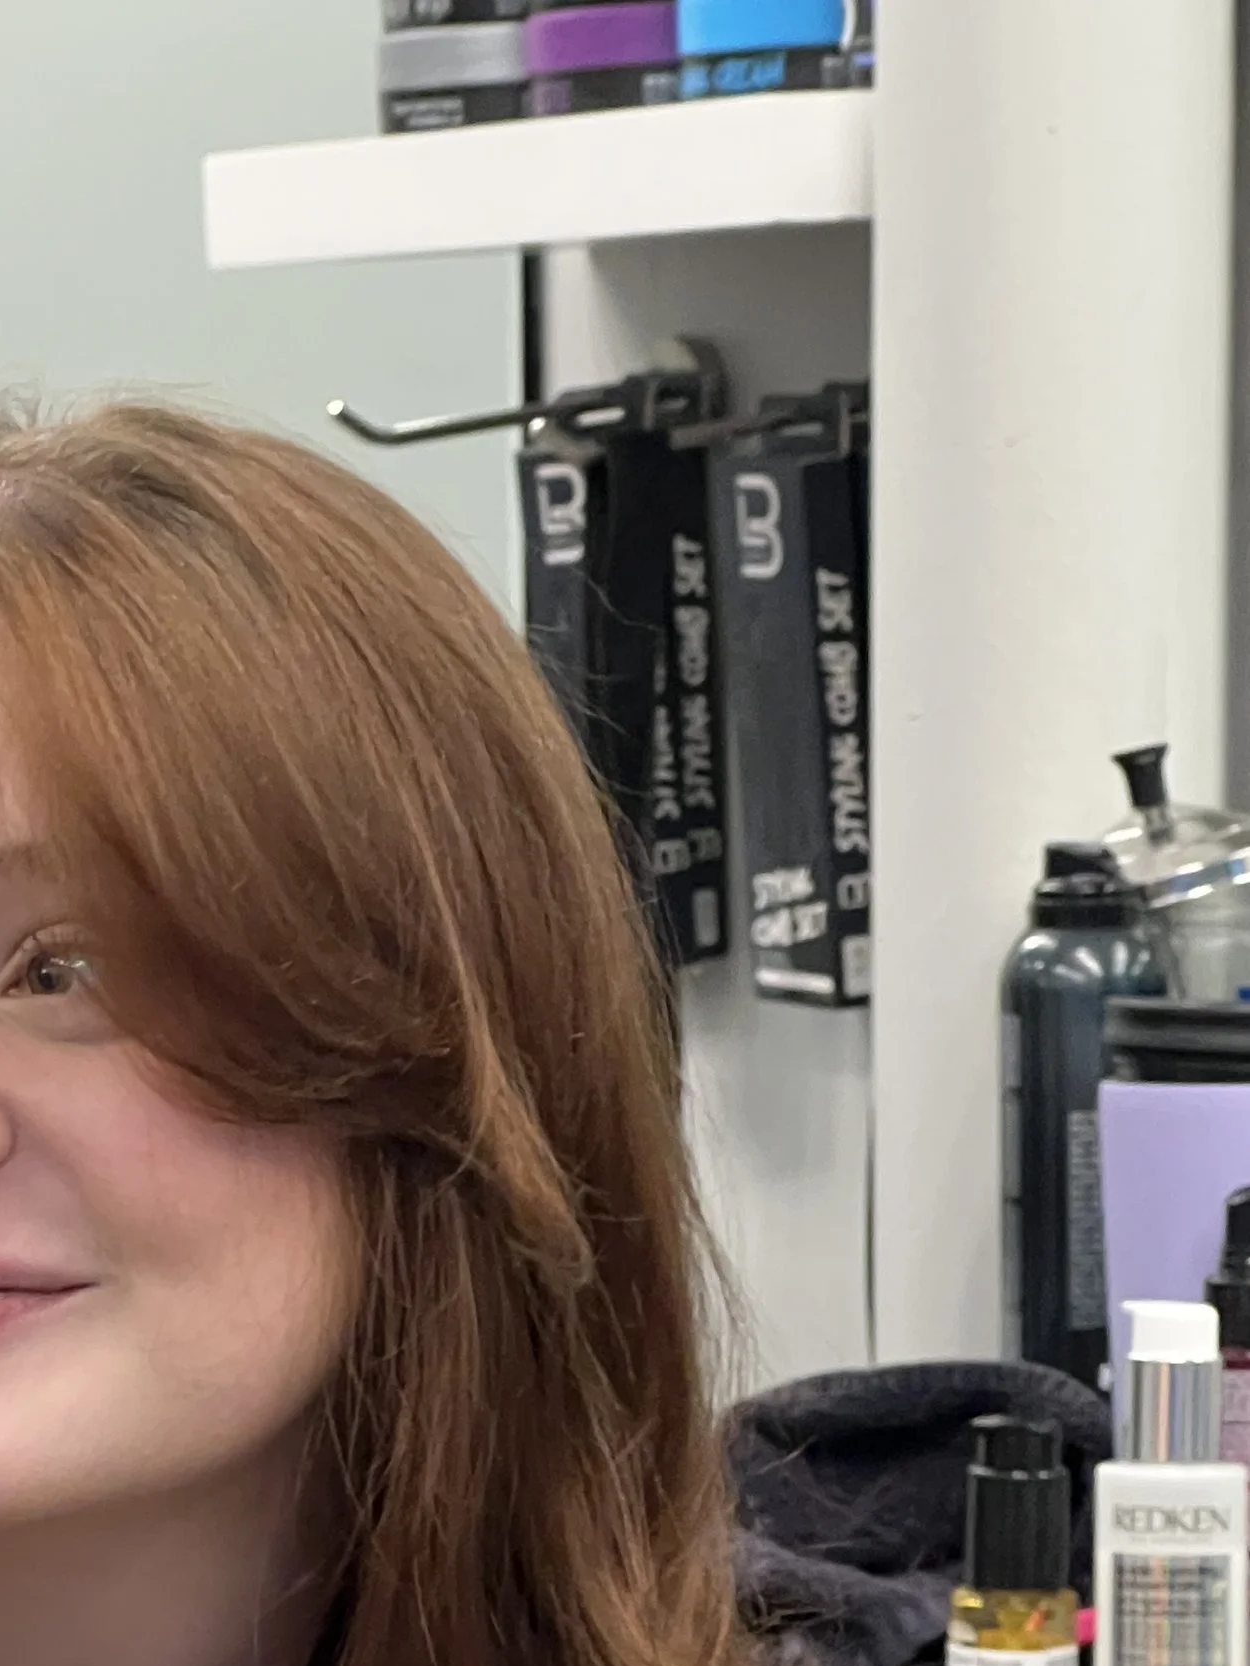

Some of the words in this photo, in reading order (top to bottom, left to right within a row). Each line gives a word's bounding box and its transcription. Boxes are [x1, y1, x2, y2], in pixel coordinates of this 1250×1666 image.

[672, 532, 707, 597] SET
[816, 566, 854, 631] SET
[1113, 1504, 1231, 1534] REDKEN
